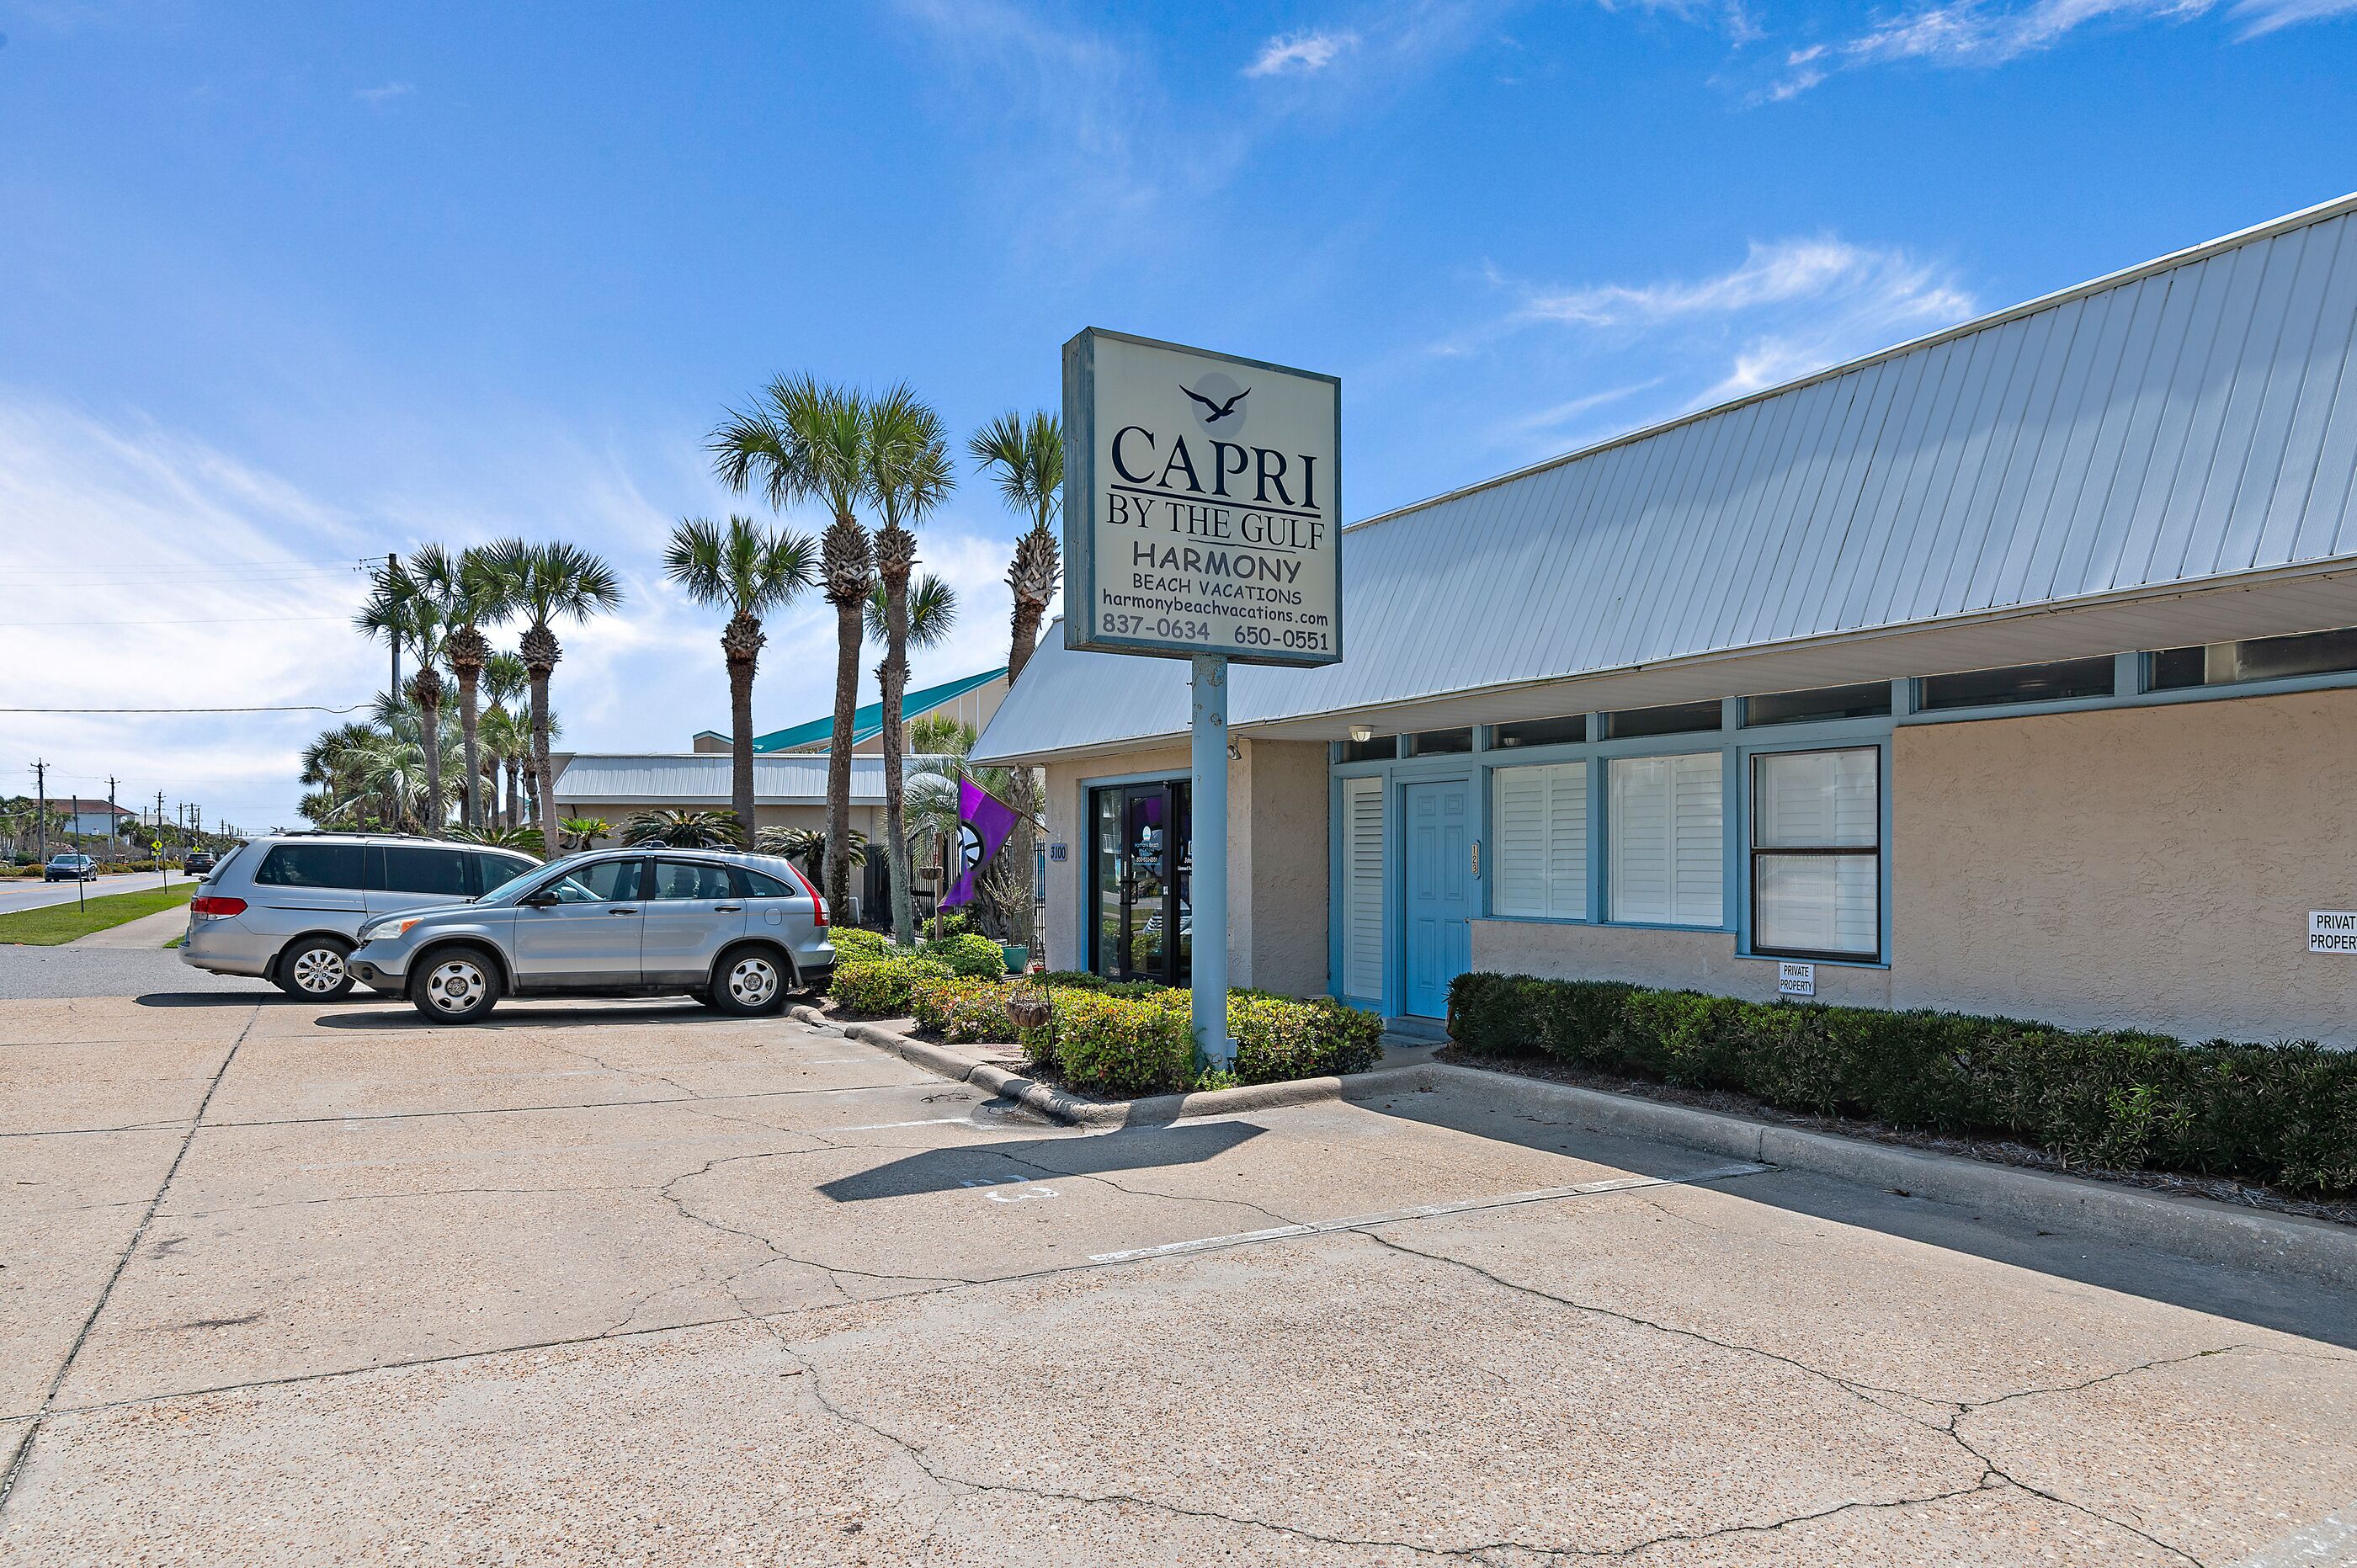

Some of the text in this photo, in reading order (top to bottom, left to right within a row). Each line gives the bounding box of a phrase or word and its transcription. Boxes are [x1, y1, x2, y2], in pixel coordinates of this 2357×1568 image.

[1110, 425, 1321, 510] CAPRI
[1105, 492, 1325, 551] BY THE GULF
[1132, 540, 1301, 584] HARMONY
[1132, 572, 1302, 605] BEACH VACATIONS
[1102, 588, 1328, 627] harmonybeachvacations.com
[1102, 612, 1328, 651] 837-0634 650-0551
[1051, 845, 1067, 859] 3100
[2317, 914, 2357, 930] PRIVAT
[2311, 933, 2357, 950] PROPER
[1780, 979, 1812, 992] PROPERTY
[1784, 965, 1810, 977] PRIVATE
